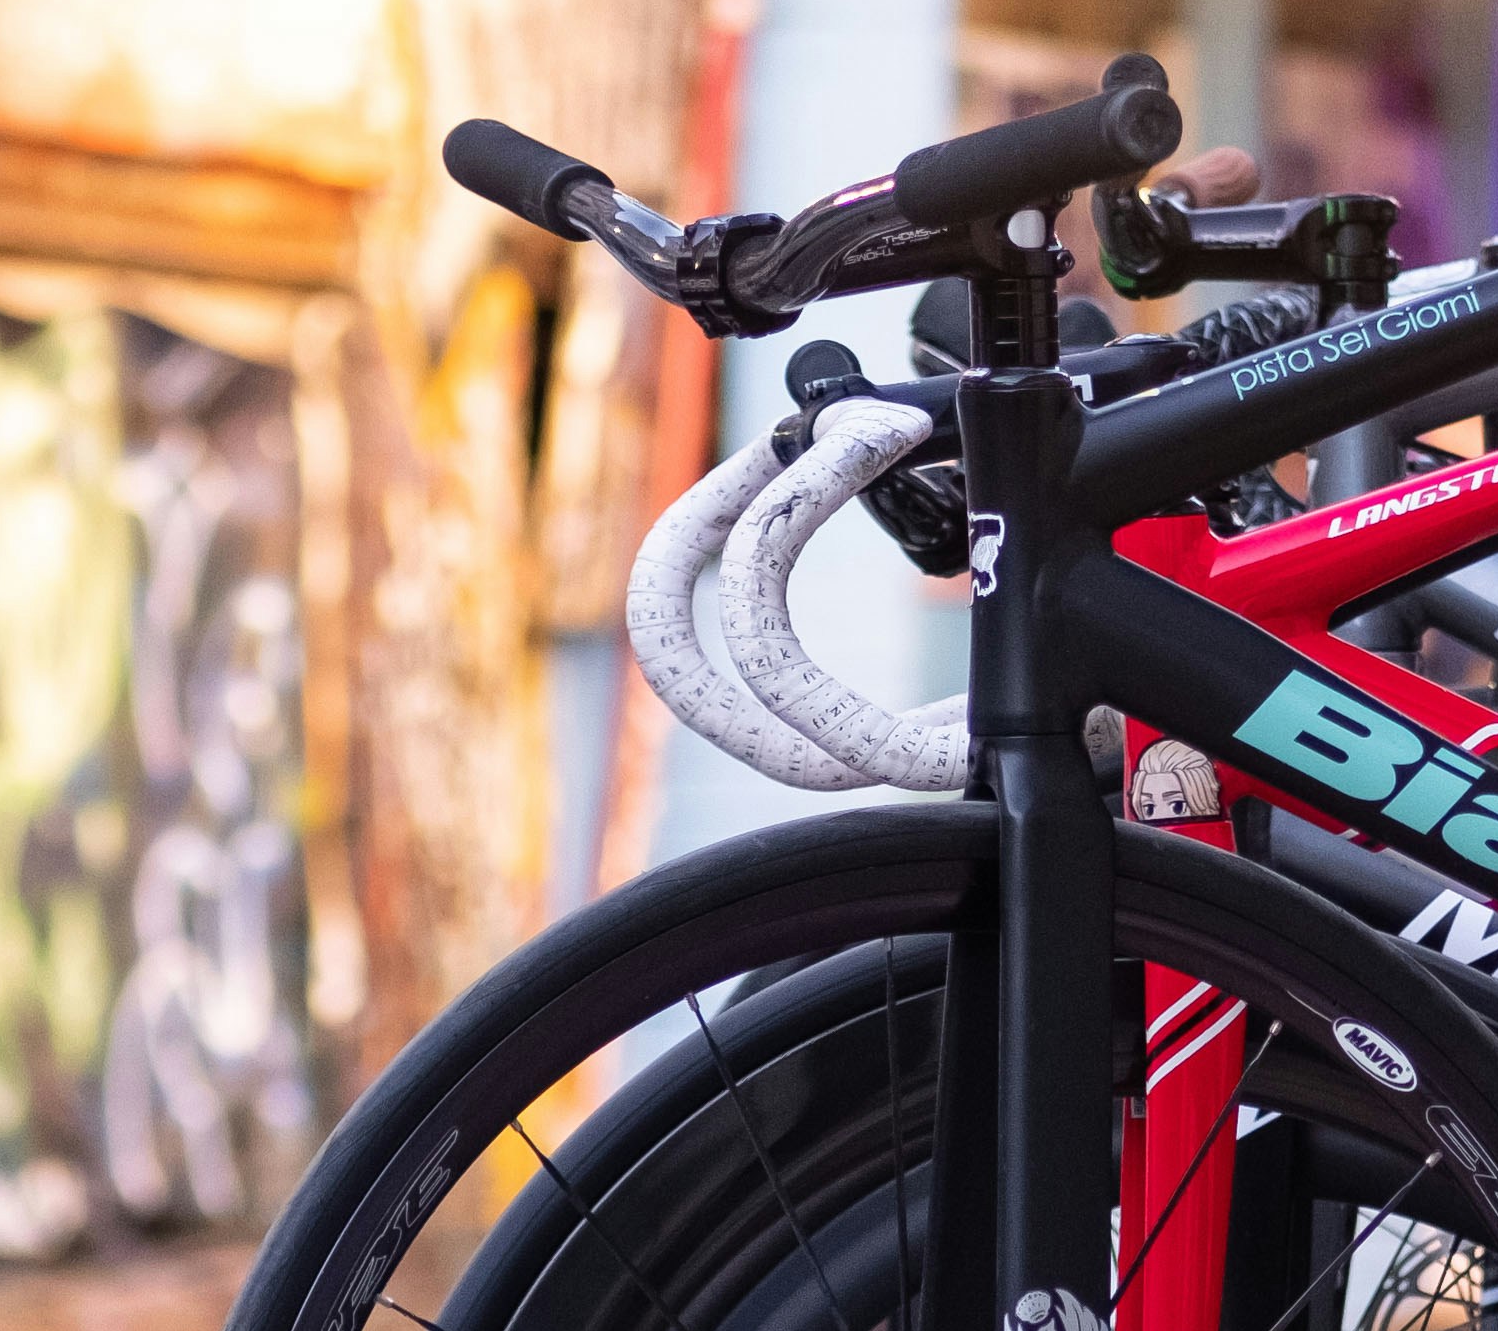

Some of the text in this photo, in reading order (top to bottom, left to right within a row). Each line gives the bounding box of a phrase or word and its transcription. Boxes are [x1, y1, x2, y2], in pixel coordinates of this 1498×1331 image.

[1230, 346, 1315, 400] pista
[1317, 322, 1373, 363] Sei
[1342, 1025, 1405, 1081] MAVIC
